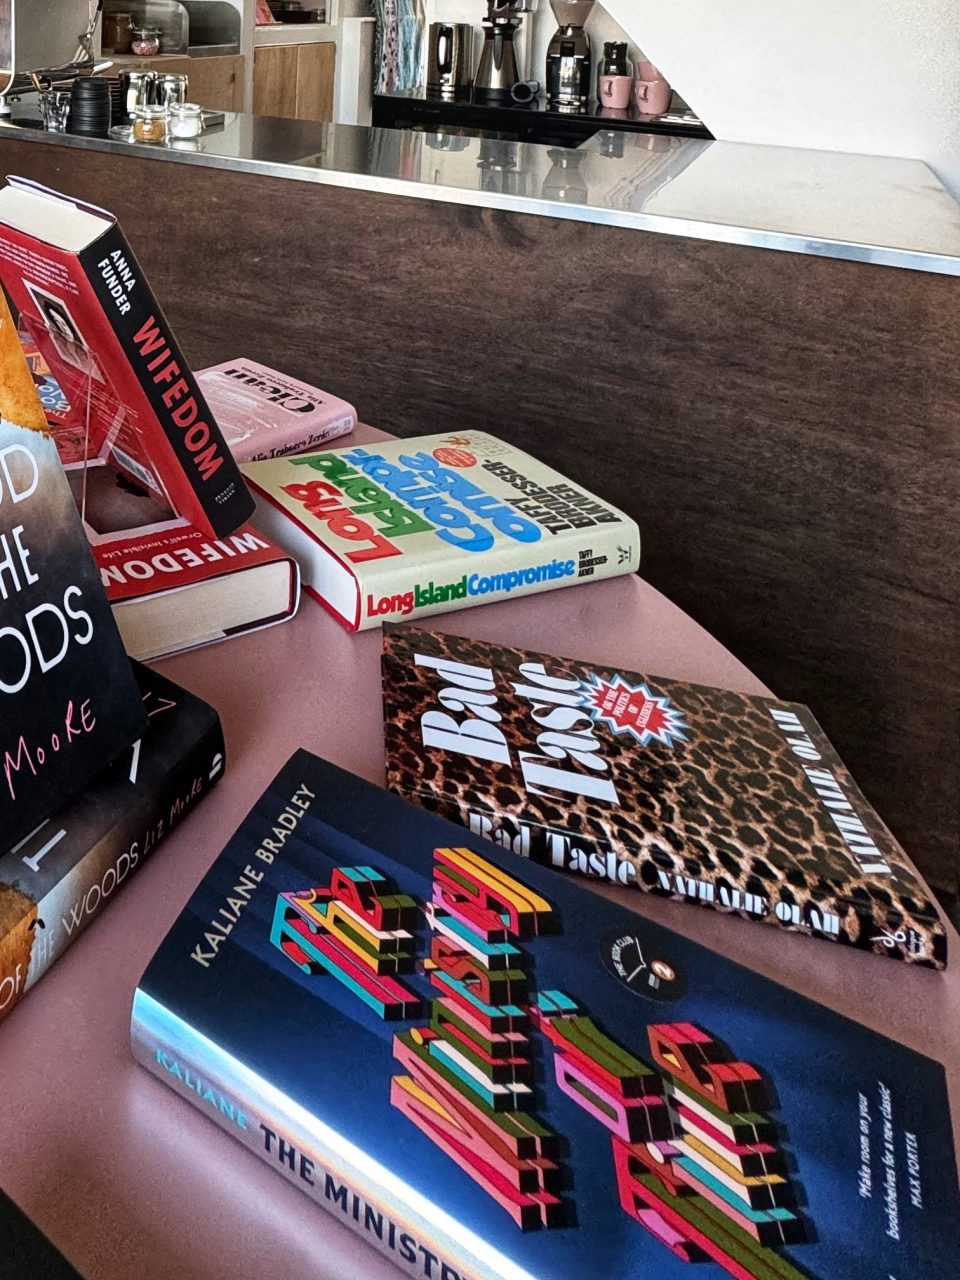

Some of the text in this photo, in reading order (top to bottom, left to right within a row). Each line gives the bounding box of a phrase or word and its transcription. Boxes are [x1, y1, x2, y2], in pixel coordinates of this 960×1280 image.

[97, 258, 131, 316] FUNDER
[110, 249, 136, 292] ANNA
[132, 315, 224, 482] WIFEDOM
[223, 368, 316, 413] Clean
[279, 481, 403, 564] Long
[288, 452, 436, 539] Island
[398, 450, 542, 544] omise
[100, 531, 202, 559] Orwell's Invisible Life
[101, 532, 269, 588] WIFEDOM
[467, 558, 576, 596] Compromise
[578, 548, 594, 560] TAFFY
[578, 565, 595, 578] AKNER
[413, 652, 514, 767] Bad
[508, 661, 620, 806] Taste
[3, 697, 97, 800] MOORE
[768, 707, 894, 878] NATHALIE OLAH
[190, 782, 317, 968] KALIANE BRADLEY
[468, 811, 841, 936] Bad Taste NATHALIE OLAH
[617, 934, 634, 947] CLUB
[259, 1122, 315, 1187] THE
[858, 1091, 872, 1198] 'Make room on your
[881, 1155, 895, 1170] for
[883, 1118, 893, 1141] new
[881, 1170, 900, 1242] bookshelves
[904, 1131, 923, 1210] MAX PORTER
